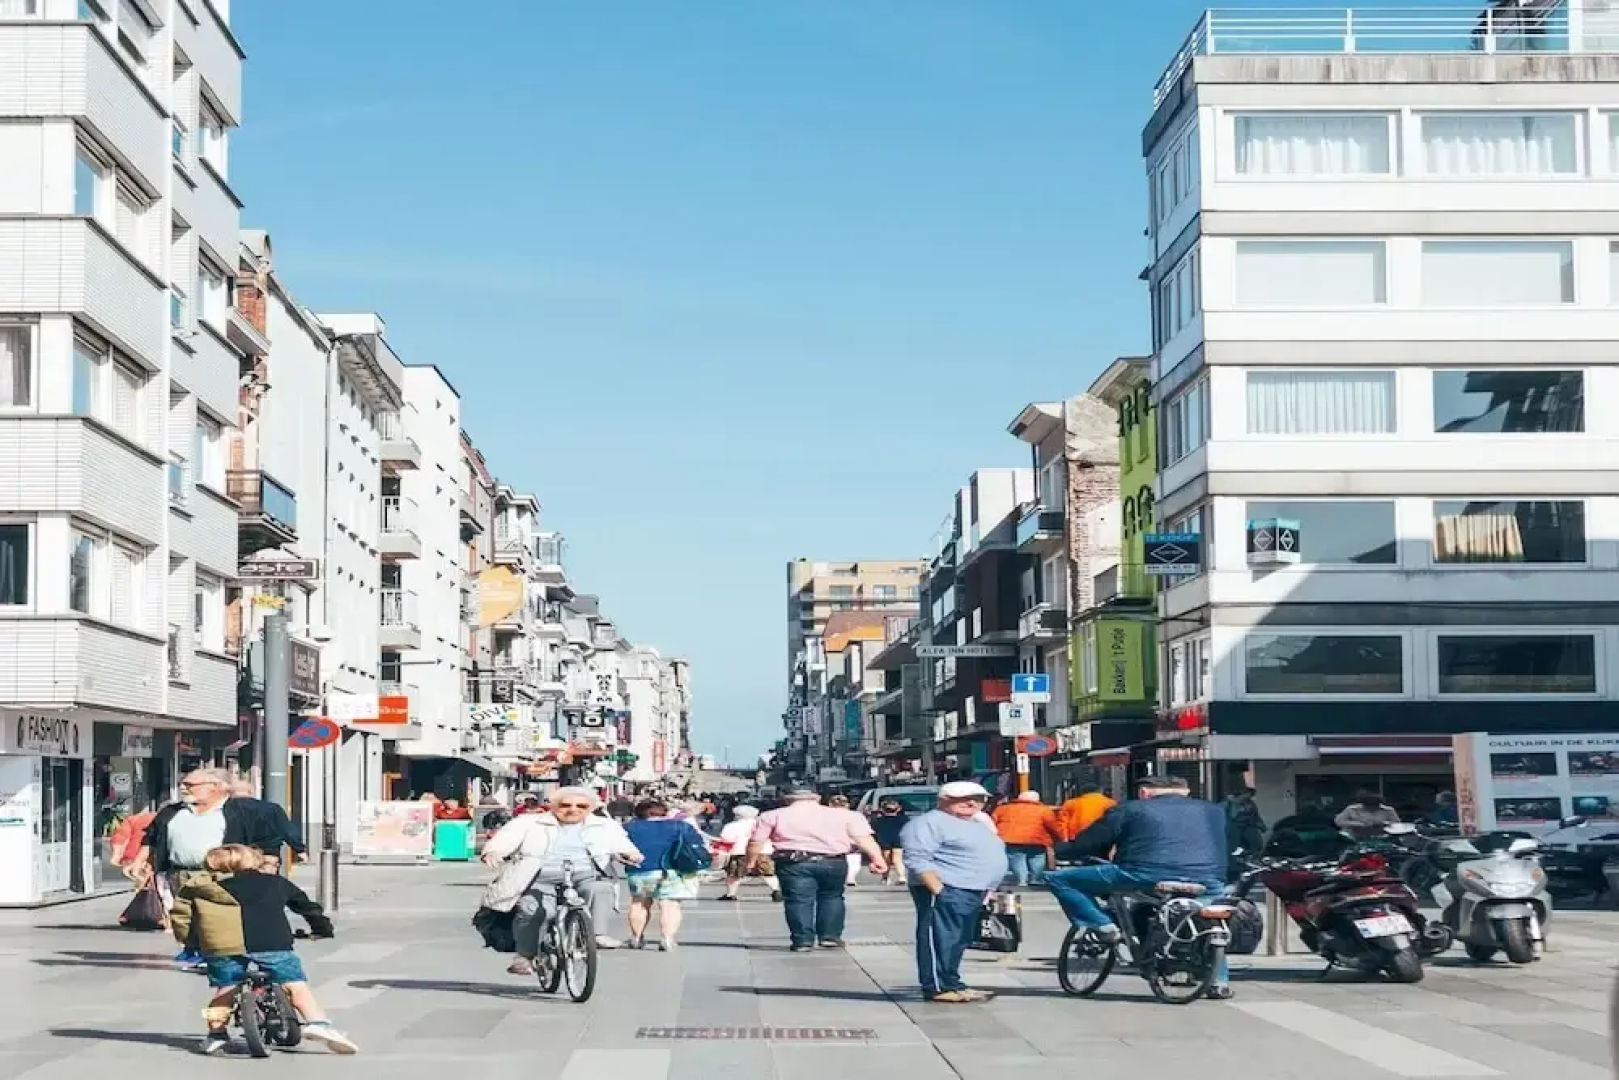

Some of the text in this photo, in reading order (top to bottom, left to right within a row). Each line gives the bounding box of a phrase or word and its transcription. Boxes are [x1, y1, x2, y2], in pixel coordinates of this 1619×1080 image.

[922, 646, 997, 656] ALFA INN HOTEL
[470, 703, 516, 723] DIVA
[1489, 739, 1547, 747] CULTUUR
